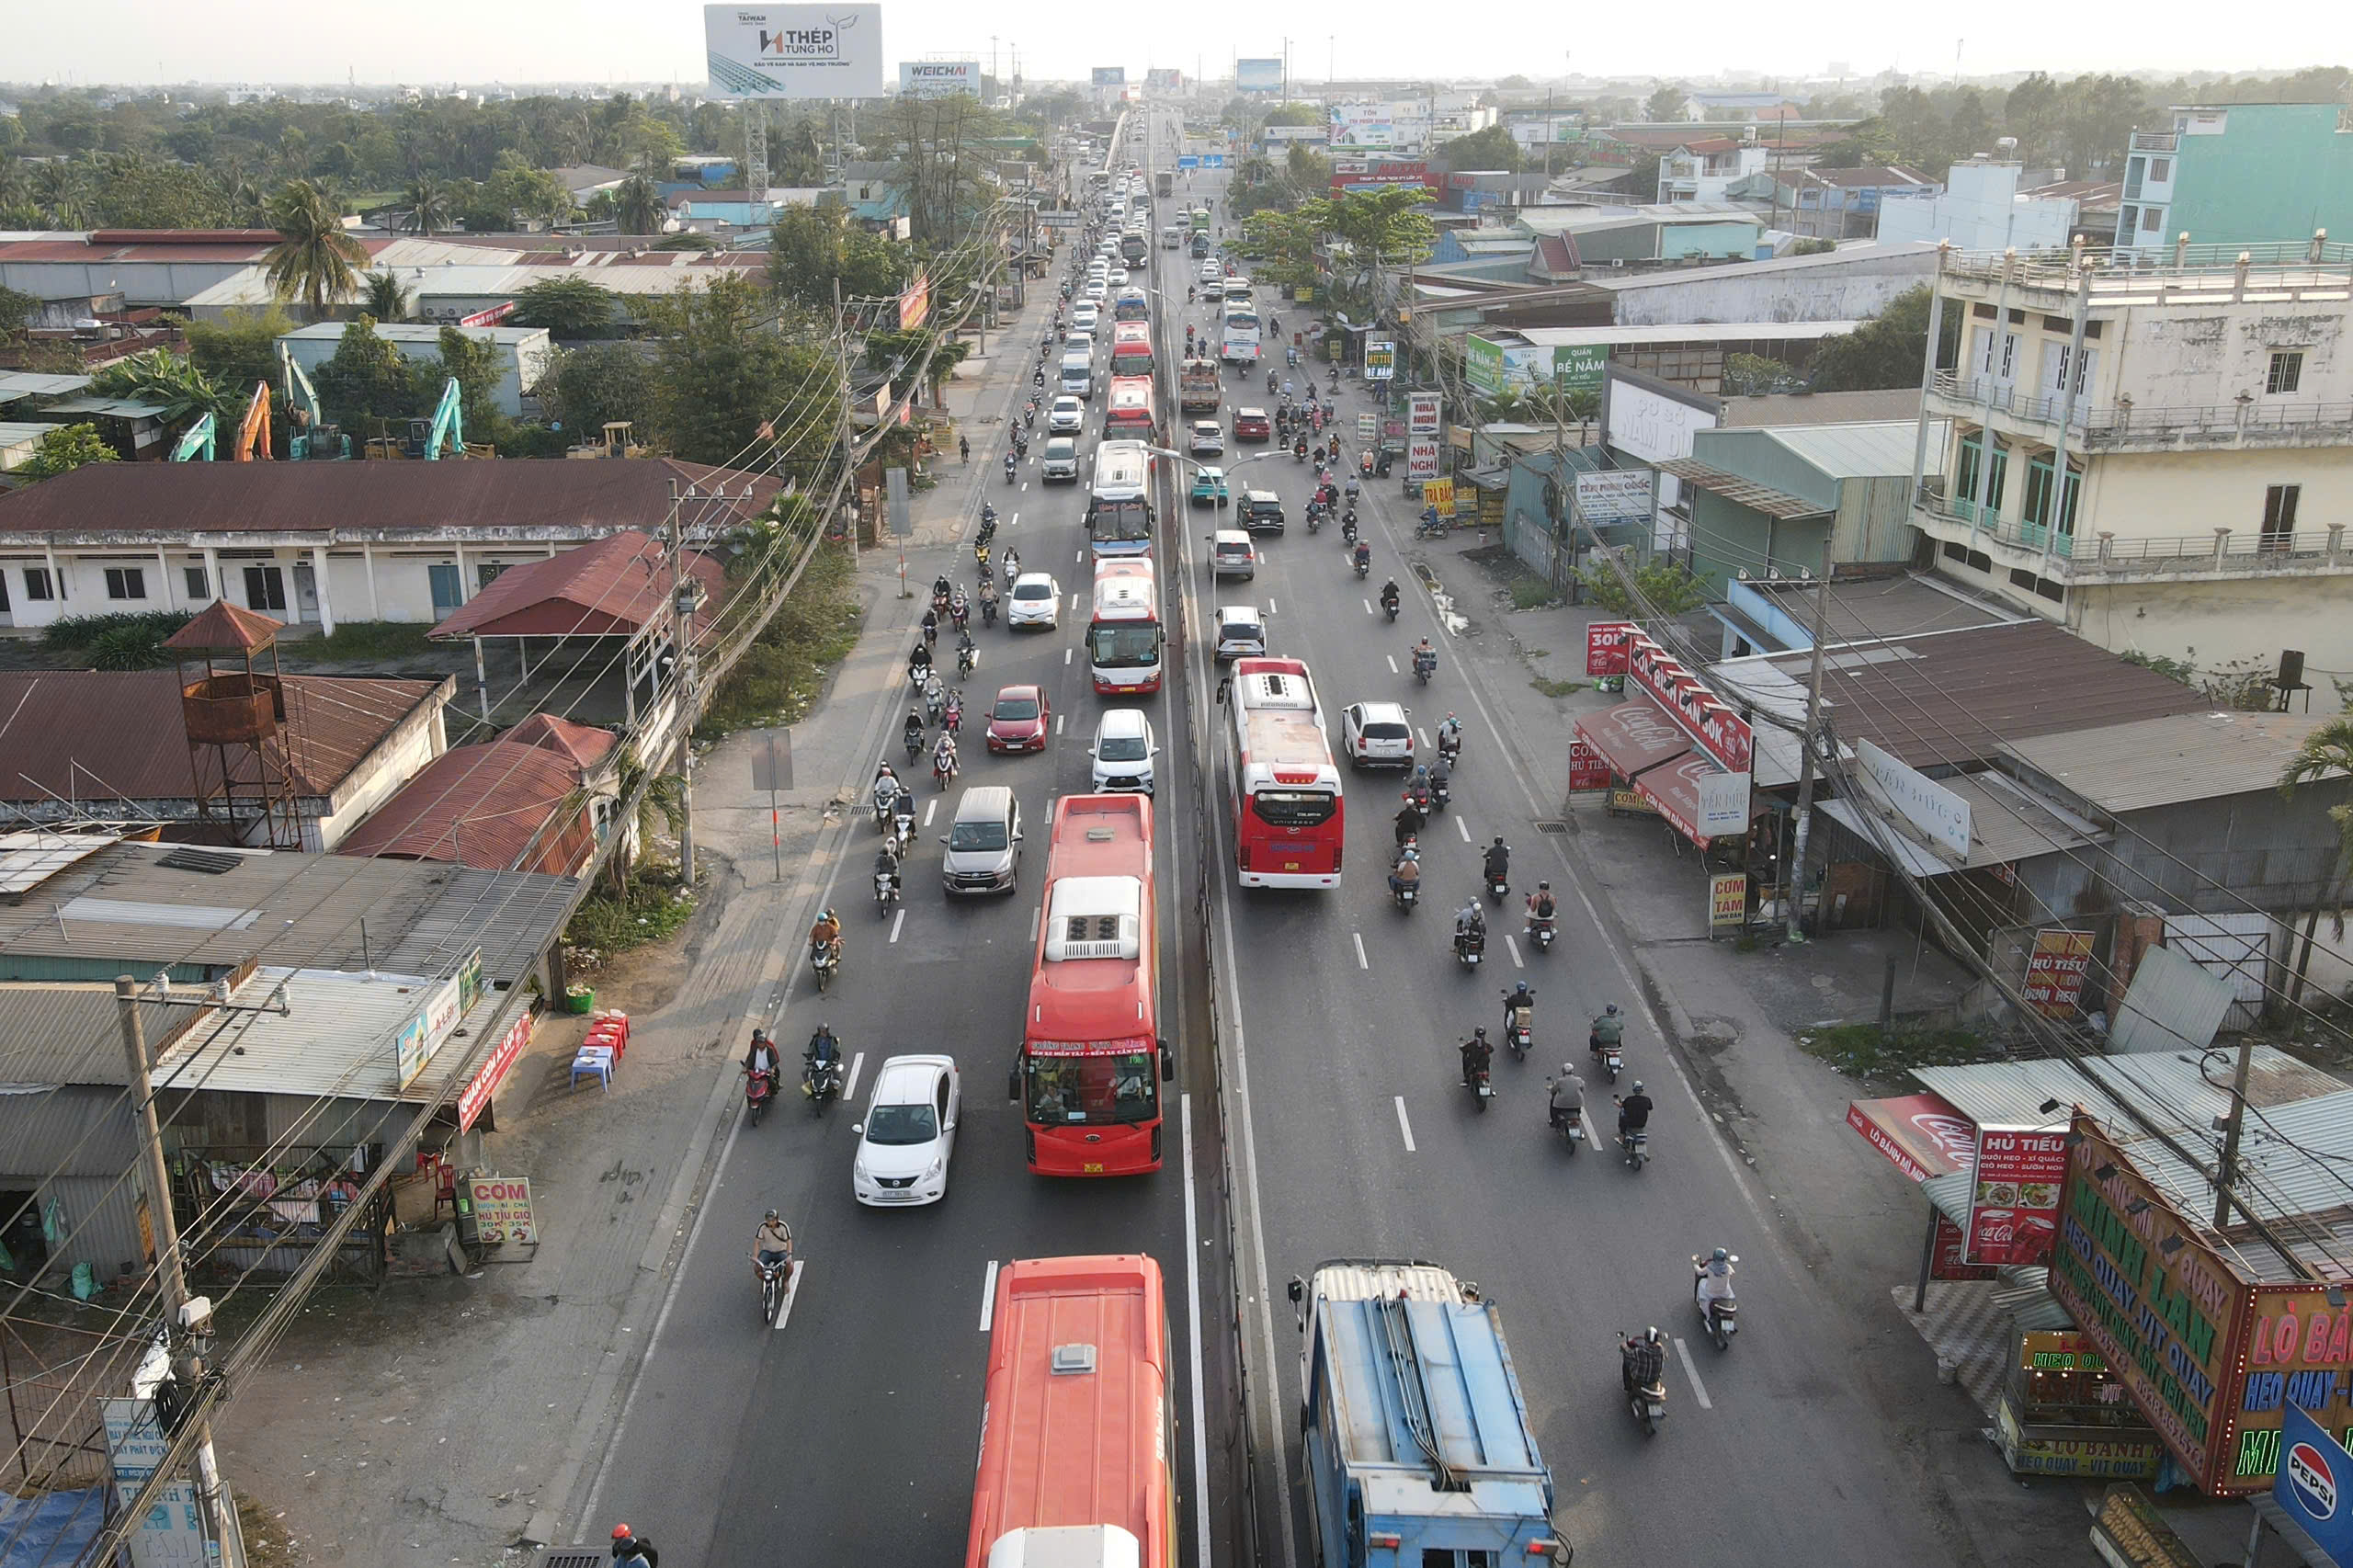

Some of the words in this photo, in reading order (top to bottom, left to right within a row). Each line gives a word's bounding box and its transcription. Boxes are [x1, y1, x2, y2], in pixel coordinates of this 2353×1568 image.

[786, 28, 833, 44] THÉP
[785, 45, 815, 54] TUNG
[912, 66, 967, 75] WEICHAI
[1378, 163, 1428, 175] MAXXIS
[1571, 347, 1592, 357] QUÁN
[1575, 358, 1605, 372] NĂM
[1415, 401, 1436, 412] NHÀ
[1413, 443, 1436, 456] NHÀ
[1715, 879, 1745, 893] CƠM
[1869, 1126, 1881, 1143] LÒ
[1878, 1134, 1902, 1163] BÁNH
[1986, 1133, 2016, 1150] HỦ
[2020, 1135, 2065, 1152] TIẾU
[1980, 1161, 1995, 1169] GIÒ
[474, 1181, 527, 1201] CƠM
[2074, 1176, 2147, 1288] MINH
[2149, 1265, 2216, 1369] LAN
[2180, 1253, 2229, 1321] QUAY
[2063, 1213, 2094, 1263] HEO
[2094, 1252, 2138, 1313] QUAY
[2168, 1341, 2216, 1408] QUAY
[2252, 1301, 2299, 1366] LÒ
[2033, 1352, 2076, 1368] HEO
[2244, 1370, 2284, 1412] HEO
[2287, 1369, 2337, 1411] QUAY
[2045, 1457, 2079, 1471] QUAY
[2114, 1460, 2147, 1473] QUAY
[2290, 1457, 2334, 1506] PEPSI
